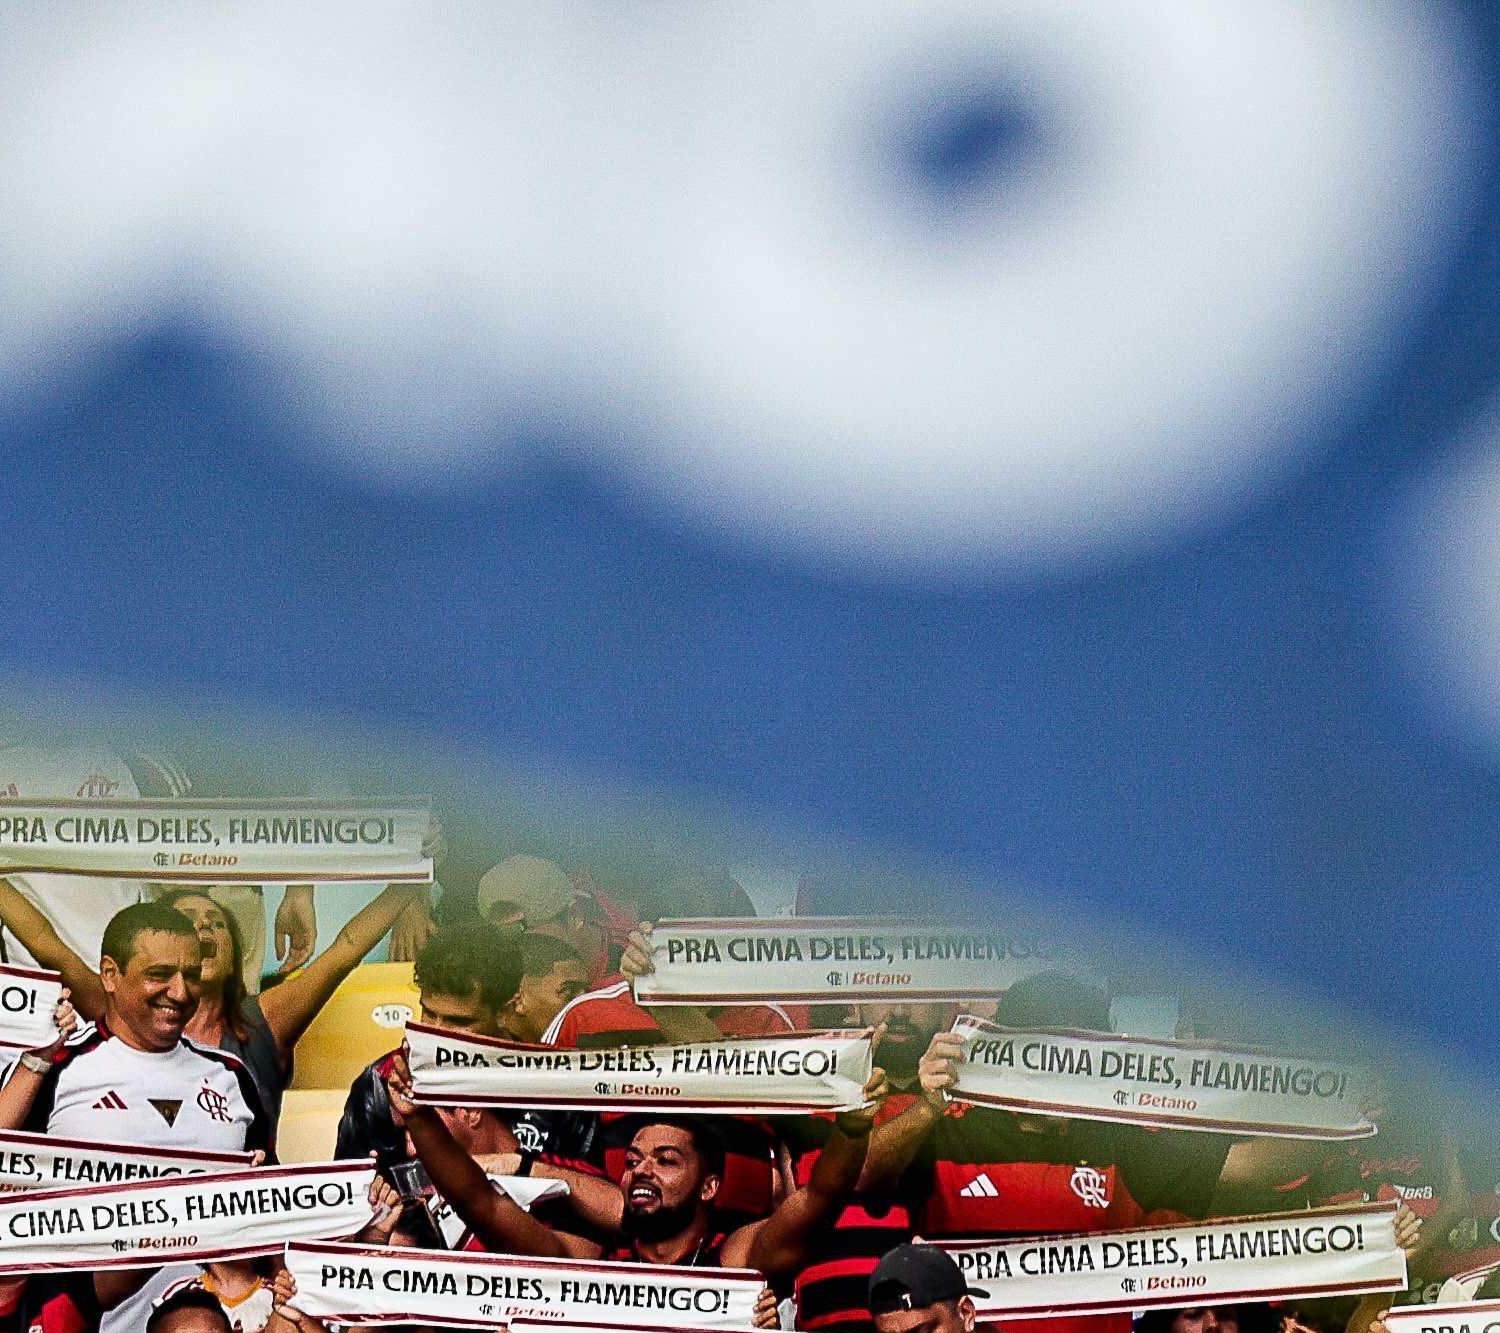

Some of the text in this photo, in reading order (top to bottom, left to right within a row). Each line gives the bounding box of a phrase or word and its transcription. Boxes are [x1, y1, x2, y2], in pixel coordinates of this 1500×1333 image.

[55, 817, 129, 843] CIMA
[137, 817, 219, 846] DELES,
[229, 816, 394, 844] FLAMENGO!
[179, 854, 237, 865] Betano
[385, 1010, 400, 1021] 10
[621, 1084, 680, 1096] Betano
[1138, 1094, 1196, 1110] Betano
[9, 1209, 84, 1237] CIMA
[92, 1199, 177, 1230] DELES,
[186, 1182, 353, 1220] FLAMENGO!
[139, 1236, 197, 1248] Betano
[1020, 1244, 1094, 1275] CIMA
[1102, 1237, 1187, 1269] DELES,
[1196, 1224, 1364, 1261] FLAMENGO!
[1148, 1277, 1206, 1289] Betano
